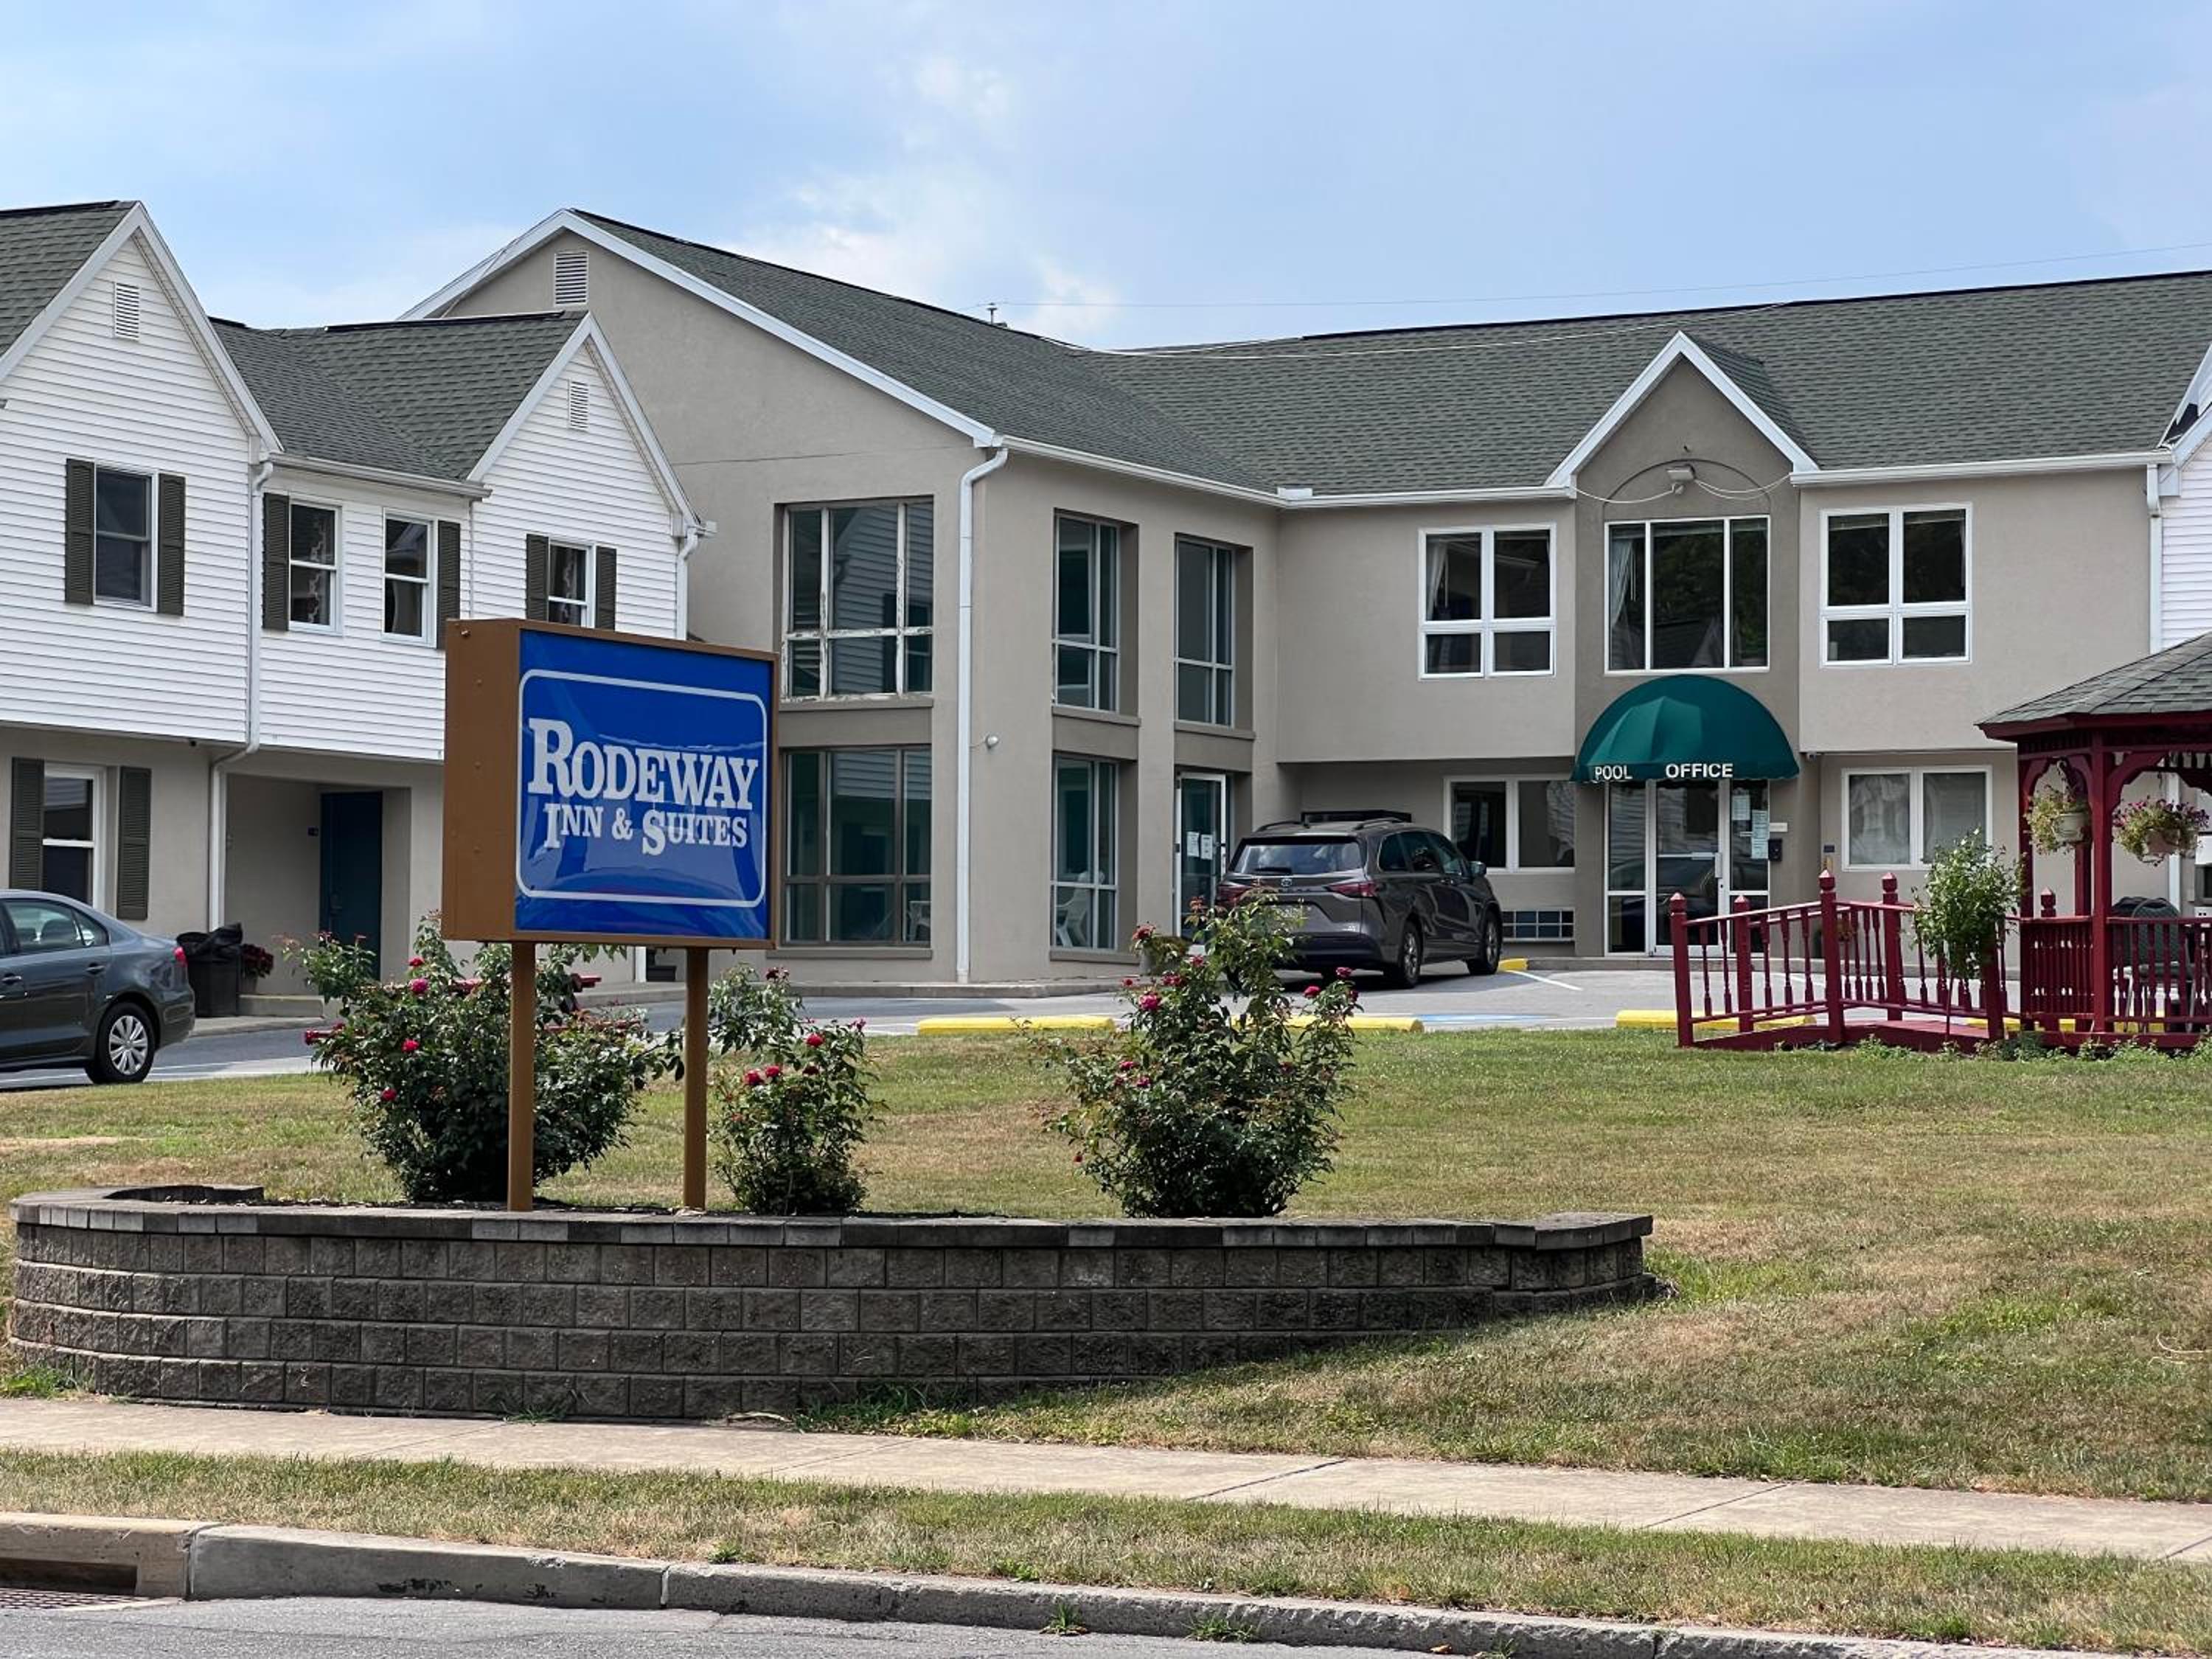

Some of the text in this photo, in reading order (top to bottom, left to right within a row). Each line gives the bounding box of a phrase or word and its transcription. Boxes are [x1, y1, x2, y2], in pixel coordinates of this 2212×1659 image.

[527, 718, 758, 810] RODEWAY
[1595, 765, 1632, 780] POOL
[1666, 763, 1733, 778] OFFICE
[543, 803, 747, 856] INN & SUITES
